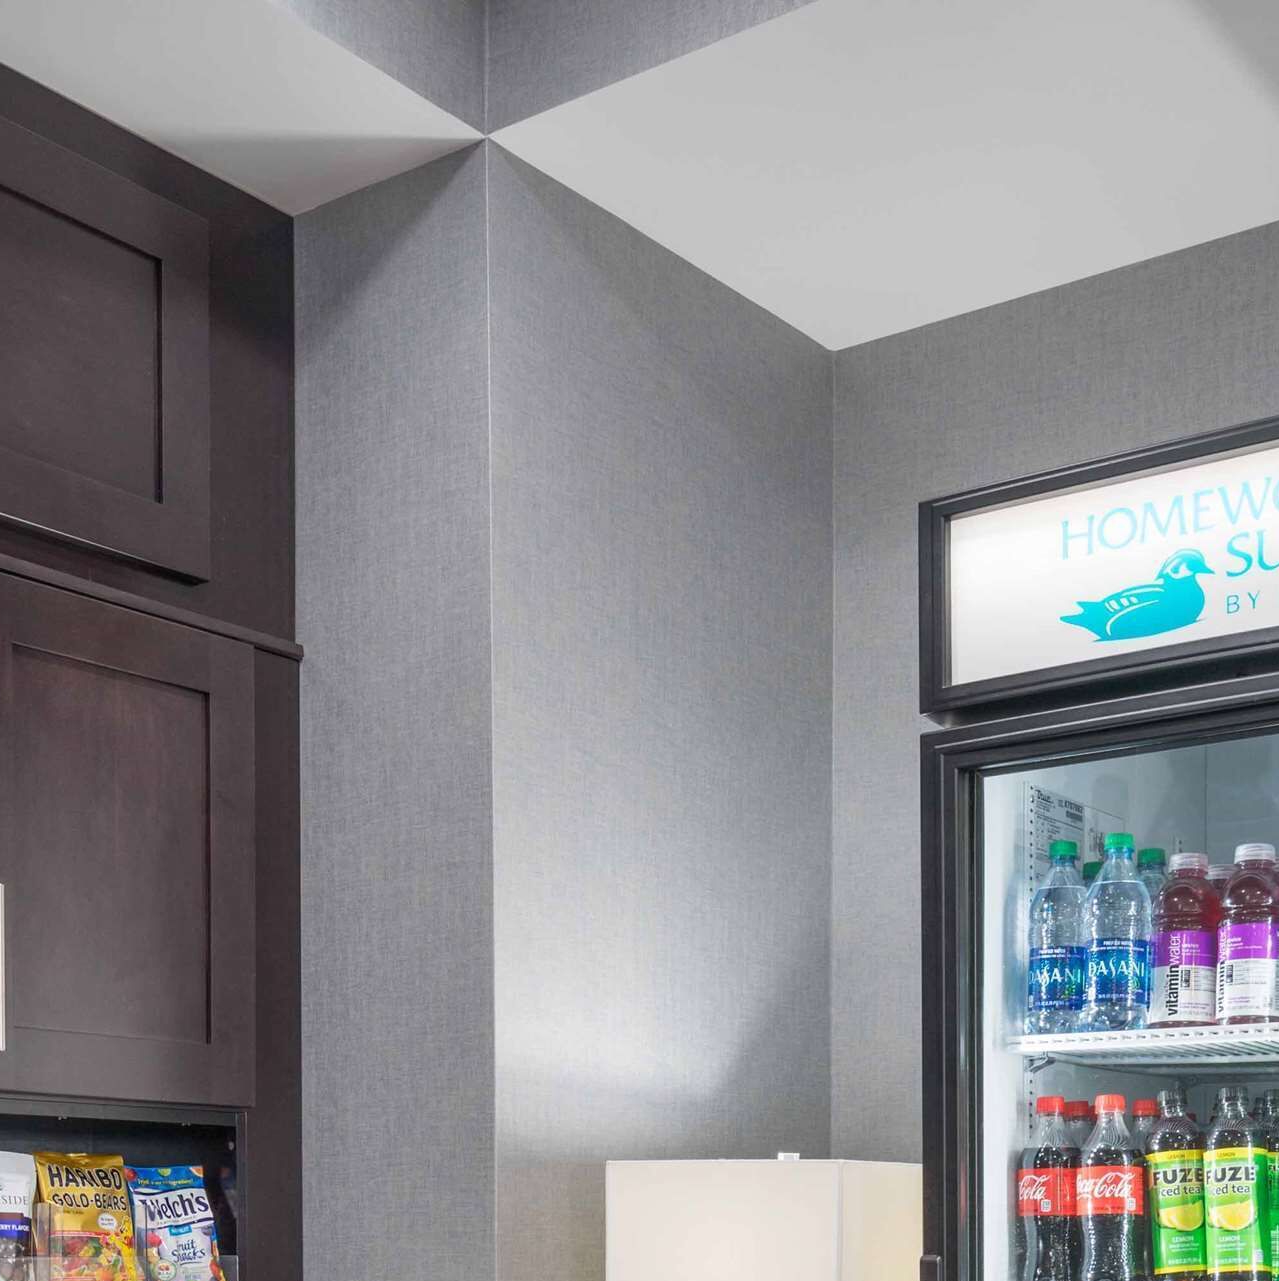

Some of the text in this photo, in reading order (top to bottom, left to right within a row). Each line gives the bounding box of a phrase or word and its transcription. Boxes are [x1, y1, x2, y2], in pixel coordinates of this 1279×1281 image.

[1226, 590, 1260, 614] BY
[1088, 960, 1145, 977] DASANI
[1167, 936, 1181, 1016] vitaminwater
[48, 1163, 122, 1190] HARIBO
[1152, 1169, 1205, 1186] FUZE
[1206, 1166, 1256, 1185] FUZE
[1183, 1185, 1201, 1196] tea
[1231, 1184, 1250, 1194] tea
[52, 1193, 128, 1211] GOLD-BEARS
[139, 1193, 209, 1221] Welch's
